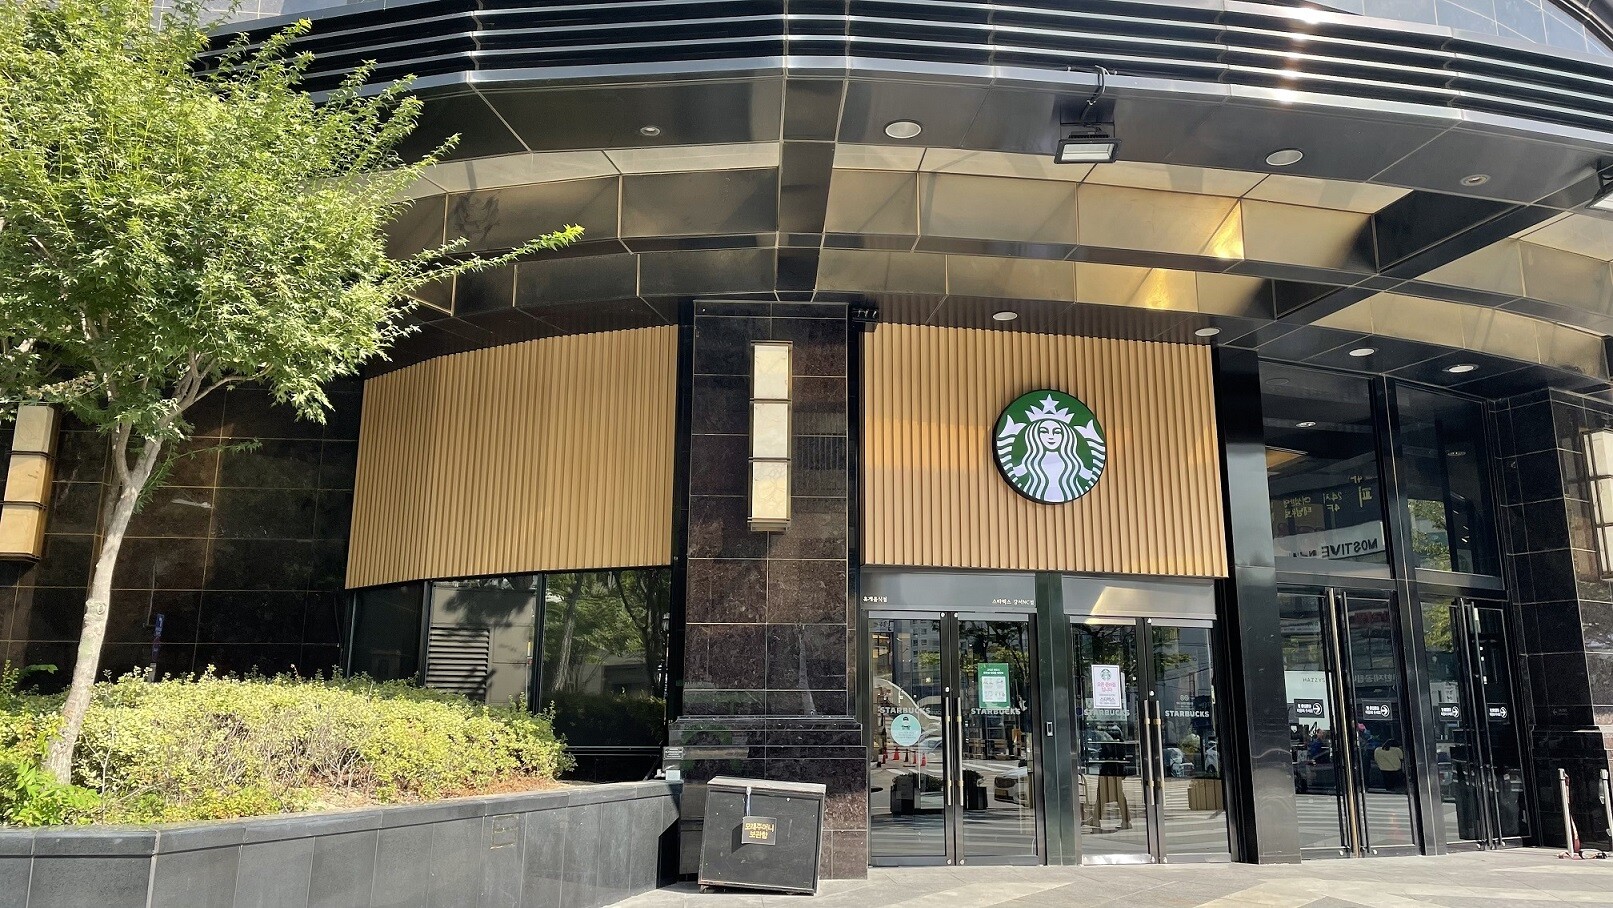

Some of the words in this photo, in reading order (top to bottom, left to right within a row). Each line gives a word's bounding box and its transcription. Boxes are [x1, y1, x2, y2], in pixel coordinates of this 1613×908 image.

[880, 706, 931, 714] STARBUCKS
[971, 707, 1021, 715] STARBUCKS
[1165, 710, 1210, 718] STARBUCKS
[744, 822, 775, 833] 모래주머니
[748, 831, 768, 840] 보관함
